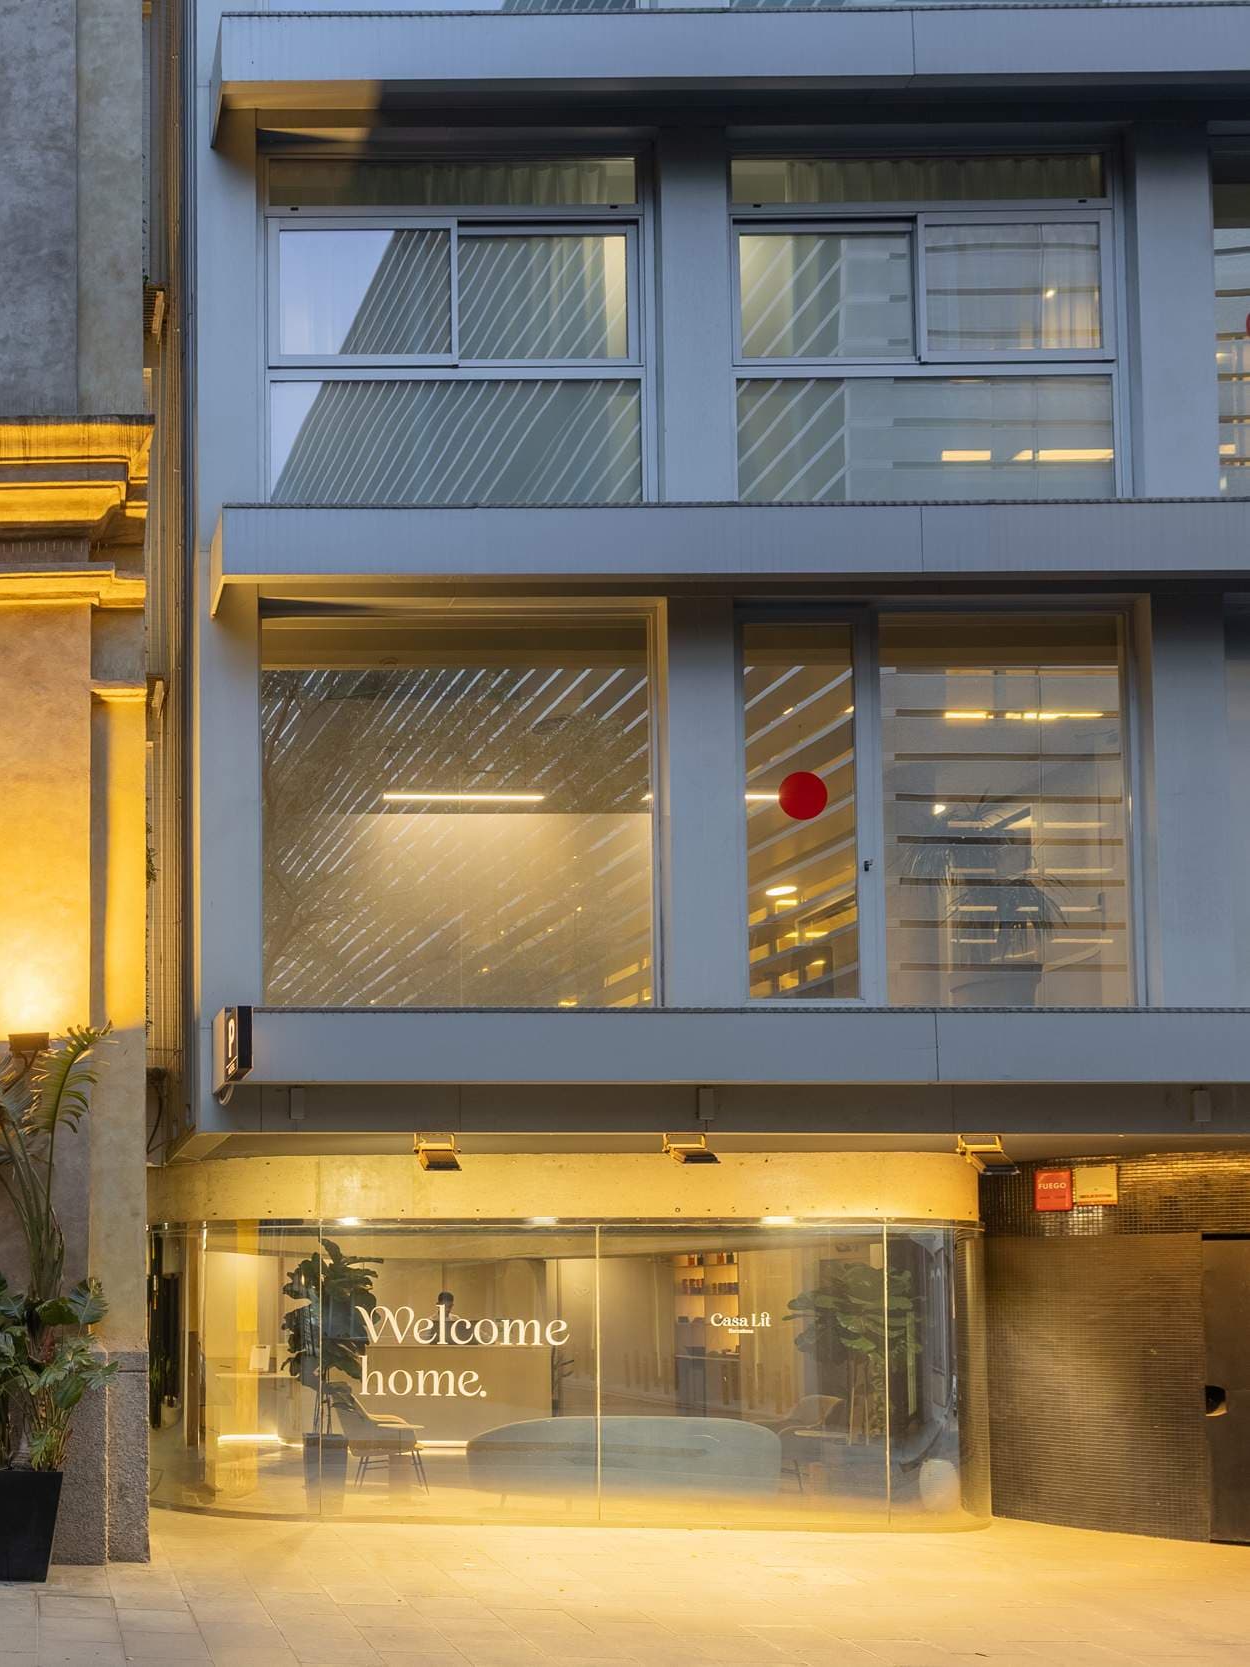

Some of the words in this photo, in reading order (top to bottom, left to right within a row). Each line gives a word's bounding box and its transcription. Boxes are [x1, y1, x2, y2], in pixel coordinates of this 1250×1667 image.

[1038, 1182, 1066, 1190] FUEGO
[355, 1304, 569, 1346] Welcome
[710, 1312, 749, 1327] Casa
[751, 1311, 771, 1327] Lit
[359, 1355, 487, 1398] home.
